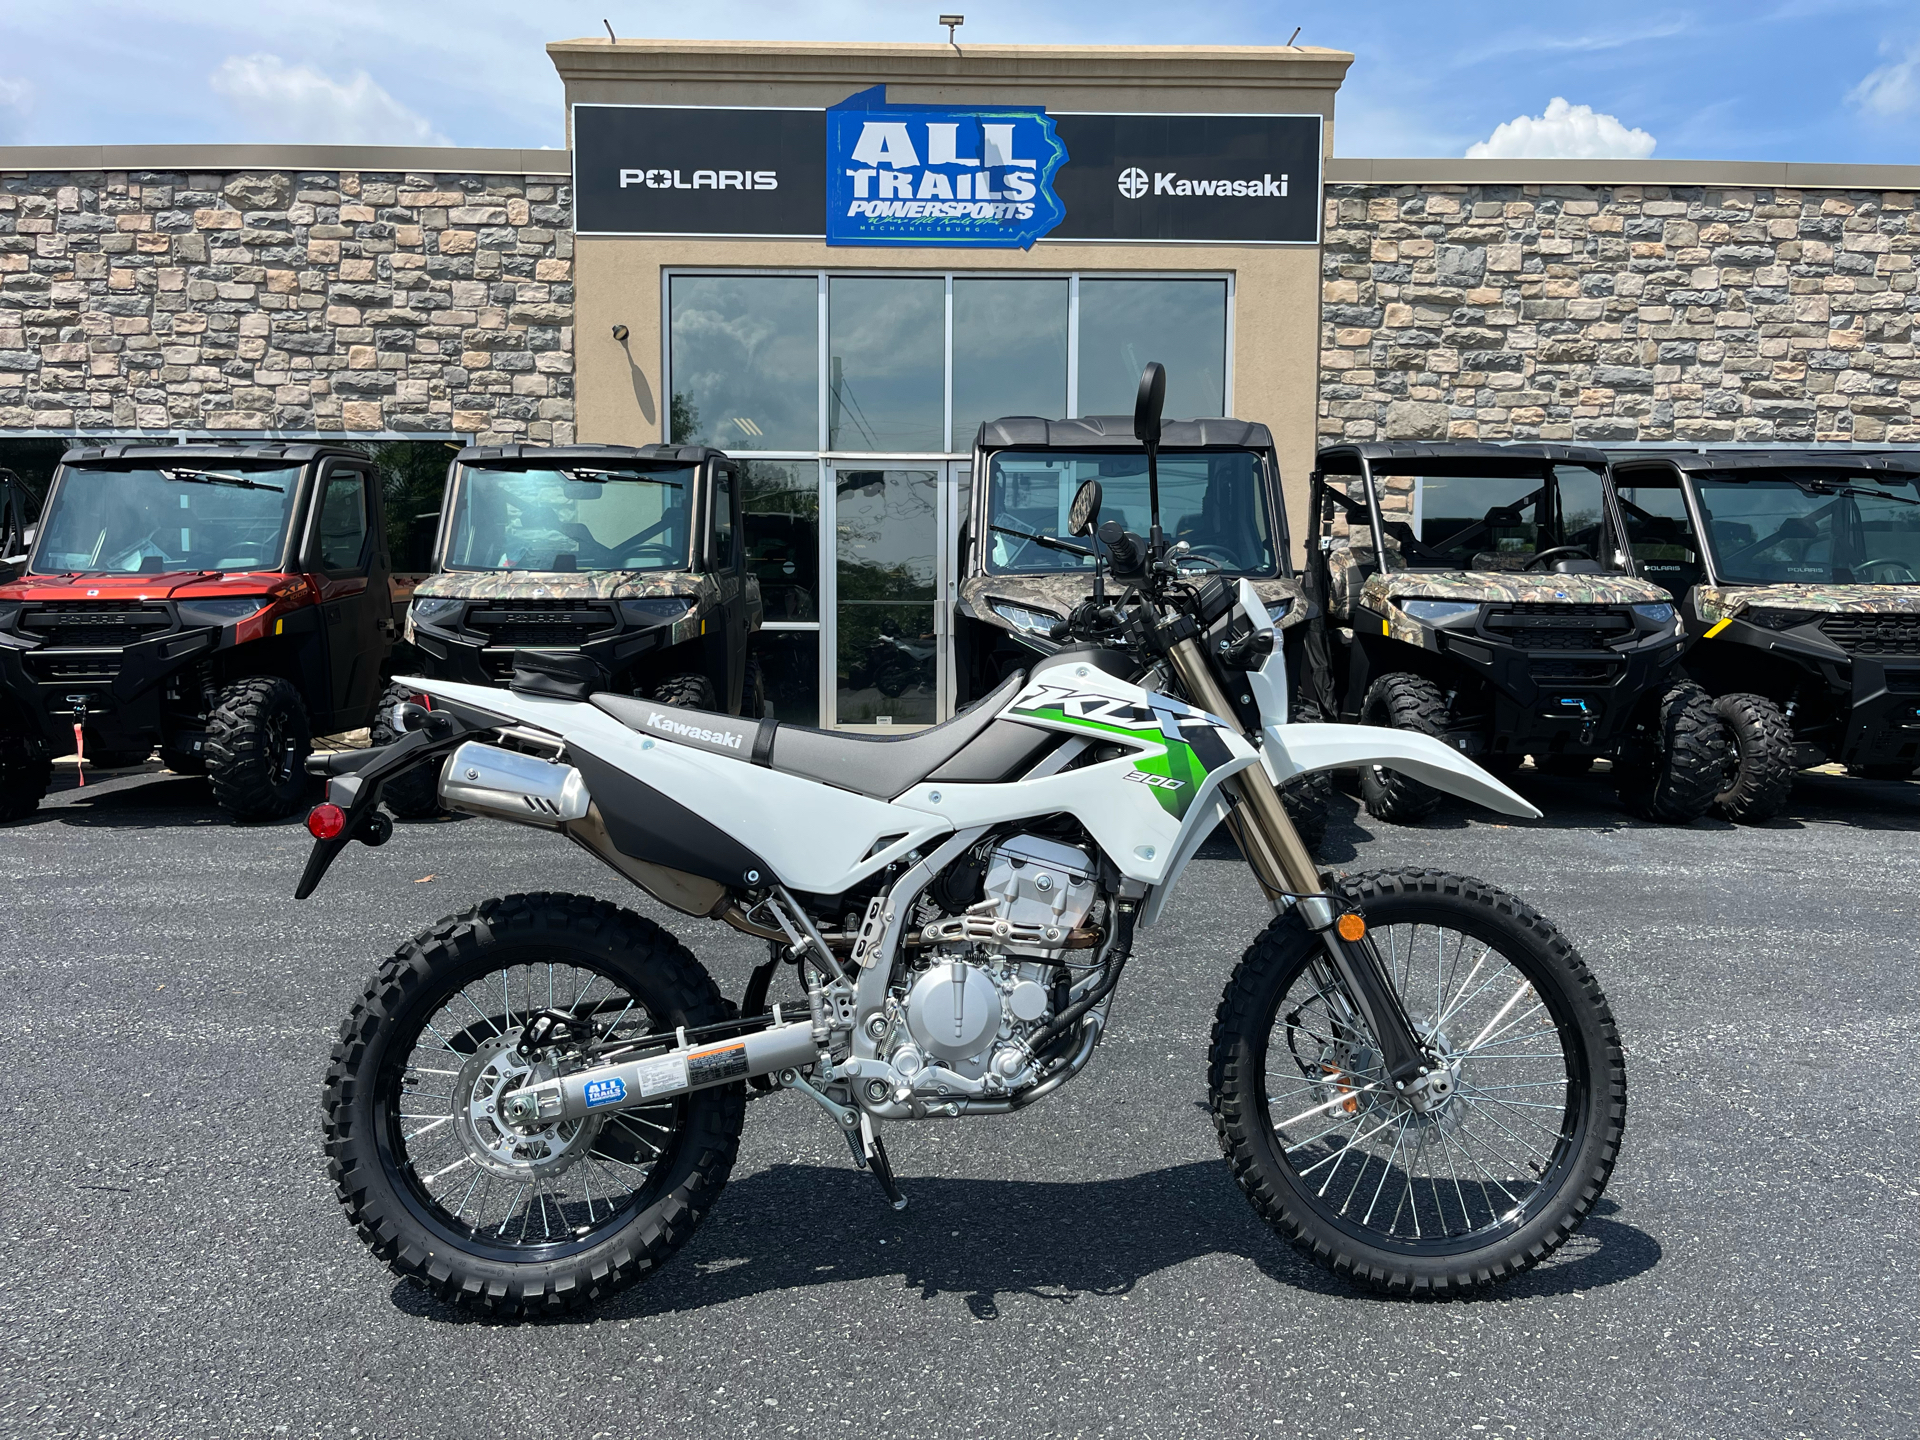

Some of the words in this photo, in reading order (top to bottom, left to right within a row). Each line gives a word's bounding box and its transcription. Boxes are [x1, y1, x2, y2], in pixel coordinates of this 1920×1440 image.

[851, 121, 1037, 171] ALL
[619, 168, 778, 190] POLARIS
[846, 168, 1037, 201] TRAILS
[1154, 172, 1289, 197] Kawasaki
[846, 200, 1036, 220] POWERSPORTS
[58, 614, 126, 625] POLARIS
[505, 614, 572, 623] POLARIS
[1012, 684, 1230, 744] KLX
[646, 711, 743, 749] Kawasaki
[1122, 769, 1188, 790] 300
[588, 1080, 621, 1094] ALL
[588, 1086, 621, 1100] TRAILS
